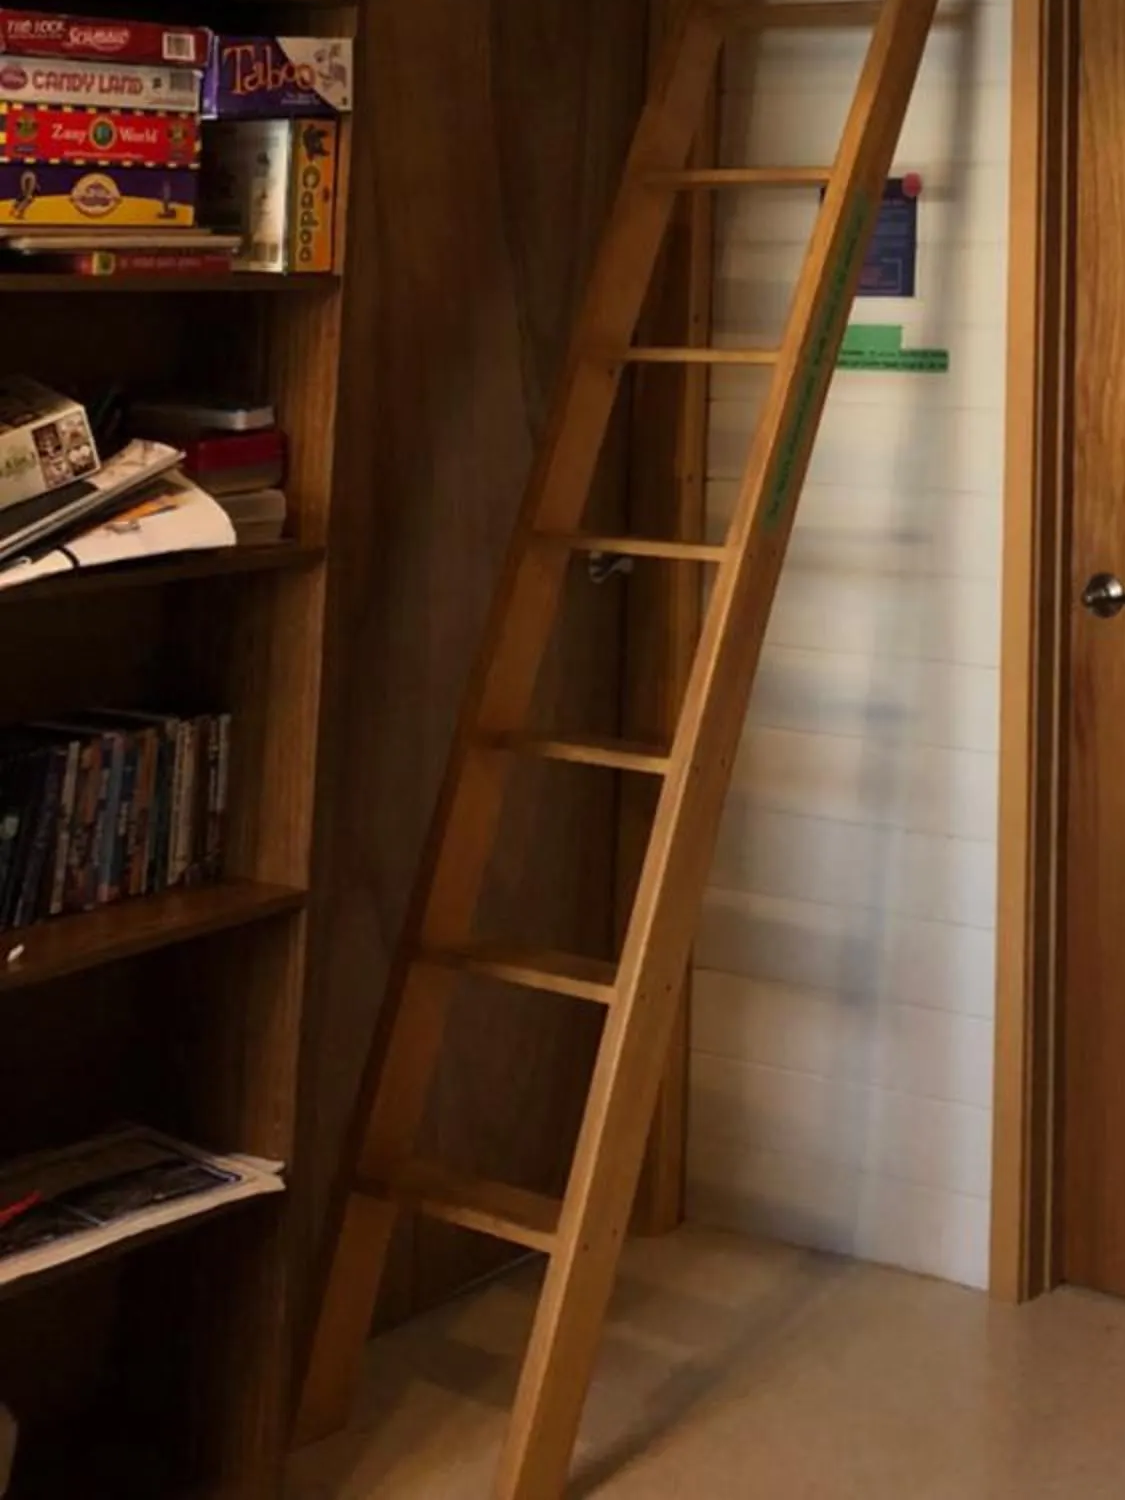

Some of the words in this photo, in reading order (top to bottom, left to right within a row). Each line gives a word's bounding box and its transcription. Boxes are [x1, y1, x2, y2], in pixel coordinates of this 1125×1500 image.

[32, 69, 97, 93] CANDY
[98, 72, 144, 96] LAND
[222, 44, 317, 95] Taboo
[119, 126, 159, 144] World
